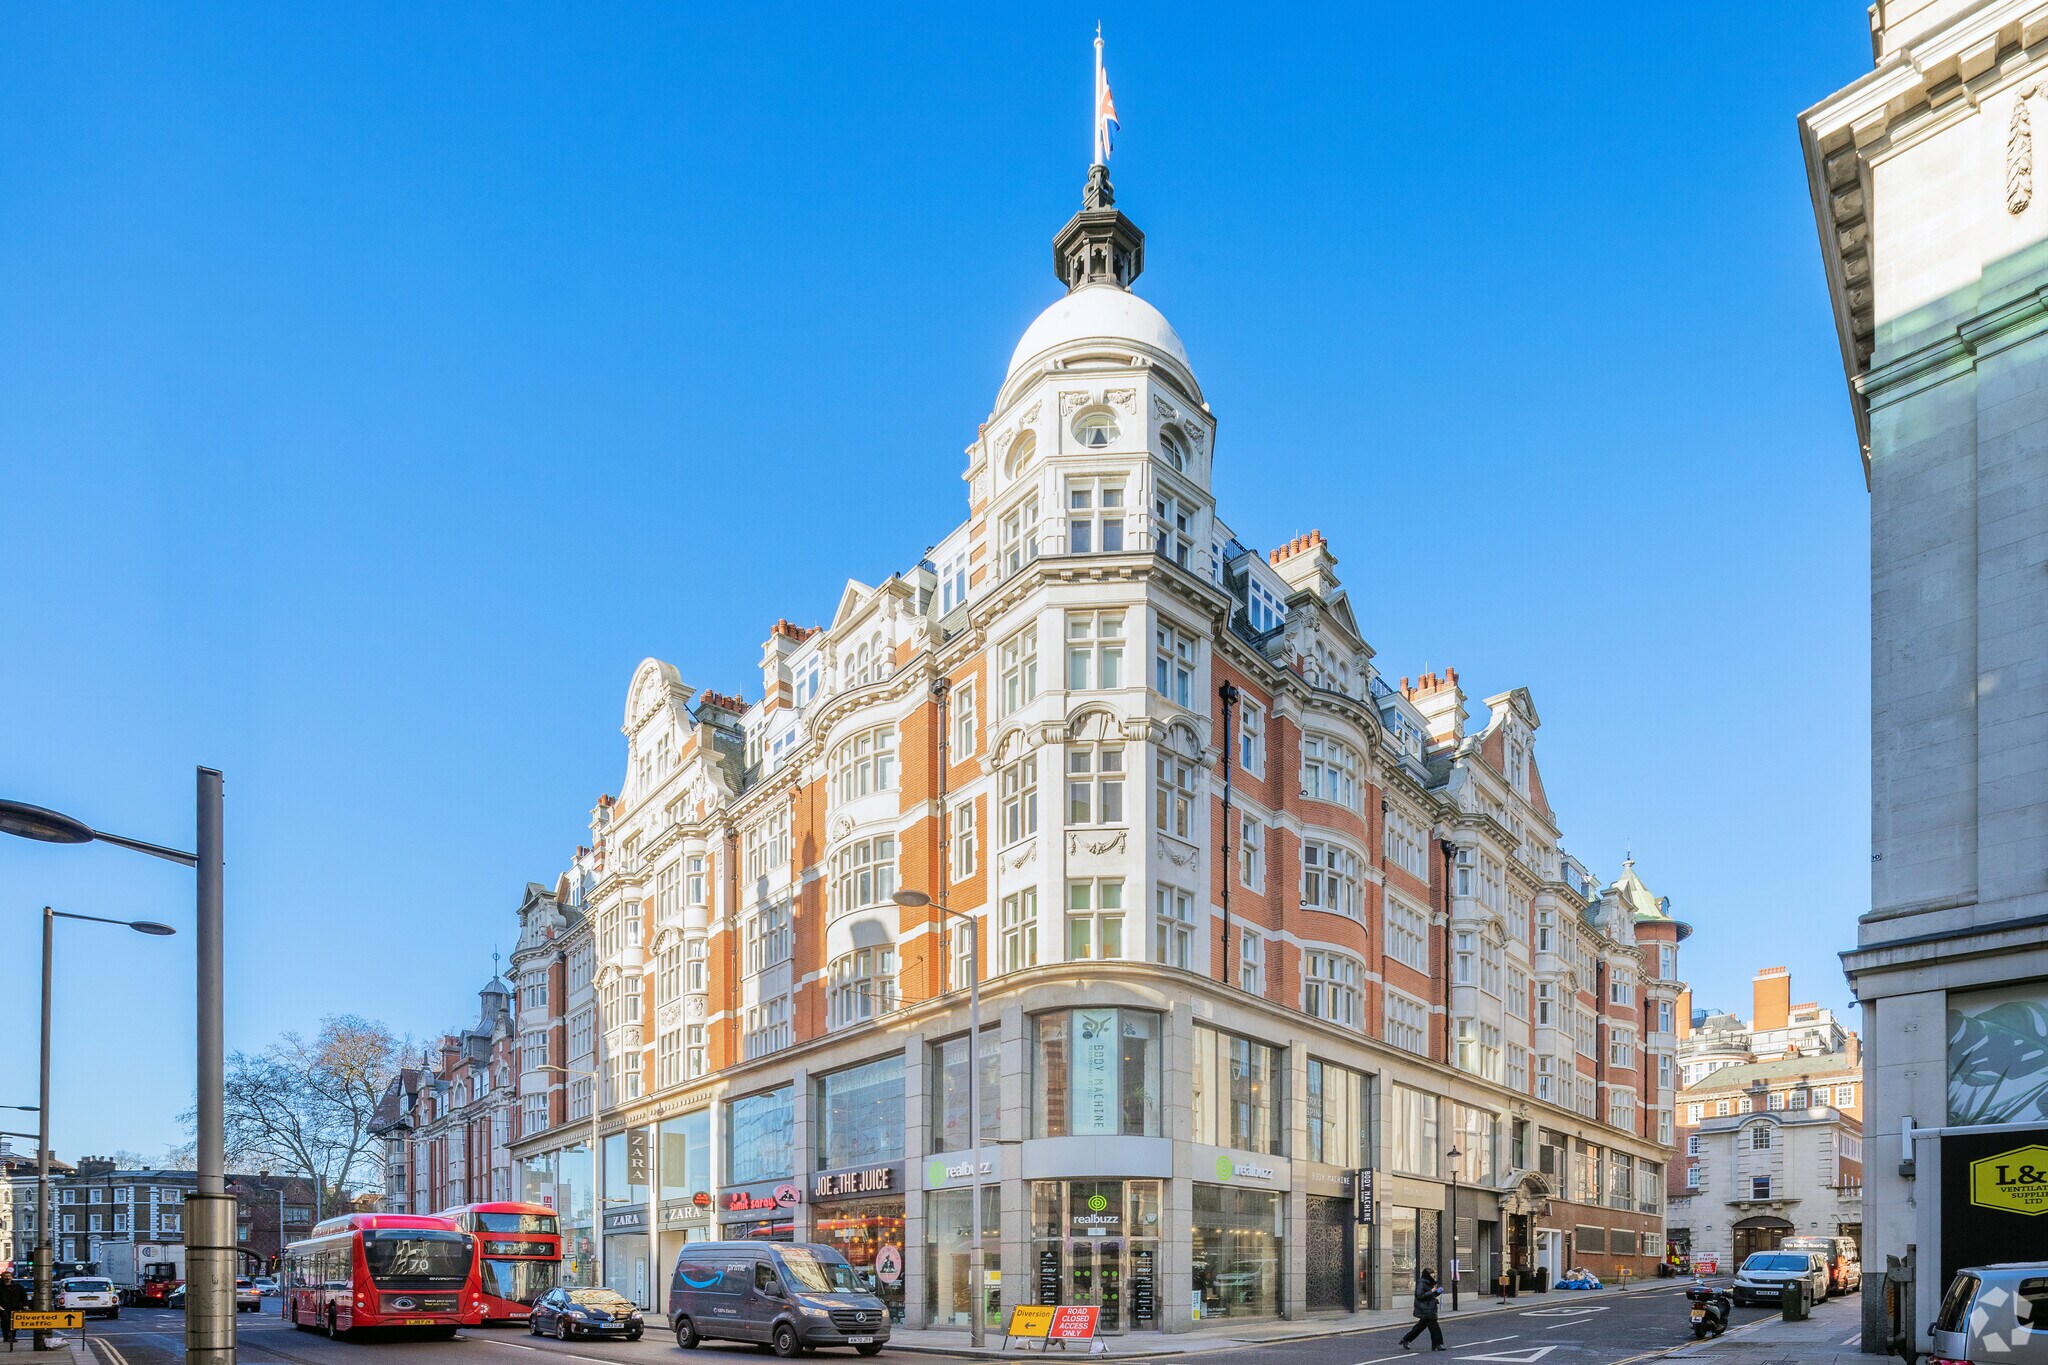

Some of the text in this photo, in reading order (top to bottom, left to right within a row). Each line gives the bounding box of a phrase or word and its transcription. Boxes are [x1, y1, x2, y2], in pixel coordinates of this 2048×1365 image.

[1093, 1044, 1104, 1128] BODY MACHINE
[631, 1136, 644, 1179] ZARA
[815, 1168, 889, 1196] JOE & THE JUICE
[670, 1207, 701, 1220] ZARA
[1073, 1214, 1119, 1224] realbuzz
[613, 1214, 639, 1226] ZARA
[538, 1245, 546, 1253] 9
[409, 1259, 429, 1270] 70
[727, 1261, 746, 1272] prime
[1016, 1309, 1050, 1317] Diversion
